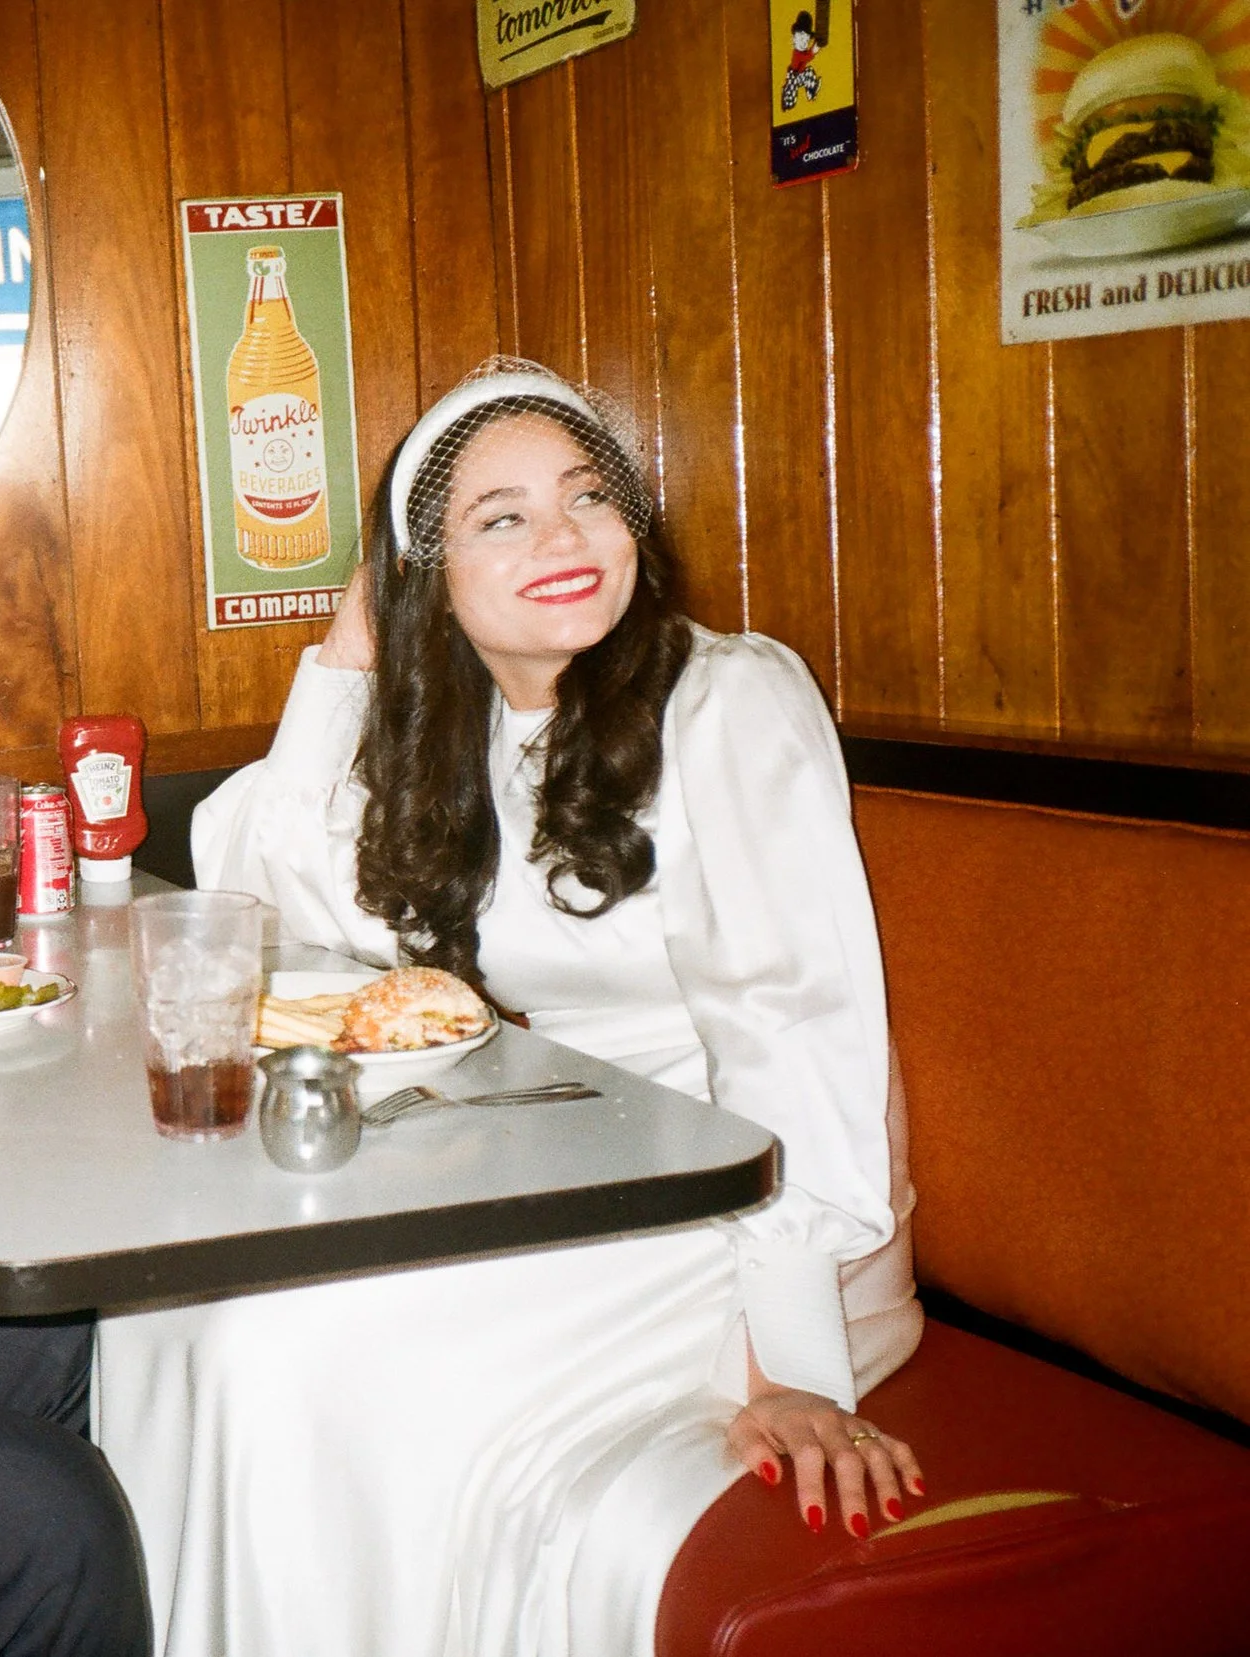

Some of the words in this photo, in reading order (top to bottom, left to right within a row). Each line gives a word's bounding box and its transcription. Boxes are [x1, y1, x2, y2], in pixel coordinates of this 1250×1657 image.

[495, 0, 604, 45] tomorr
[204, 200, 323, 229] TASTE!
[1023, 282, 1092, 317] FRESH
[1102, 273, 1147, 306] and
[231, 400, 317, 435] Twinkle
[240, 467, 322, 494] BEVERAGES
[89, 763, 116, 772] HEINZ
